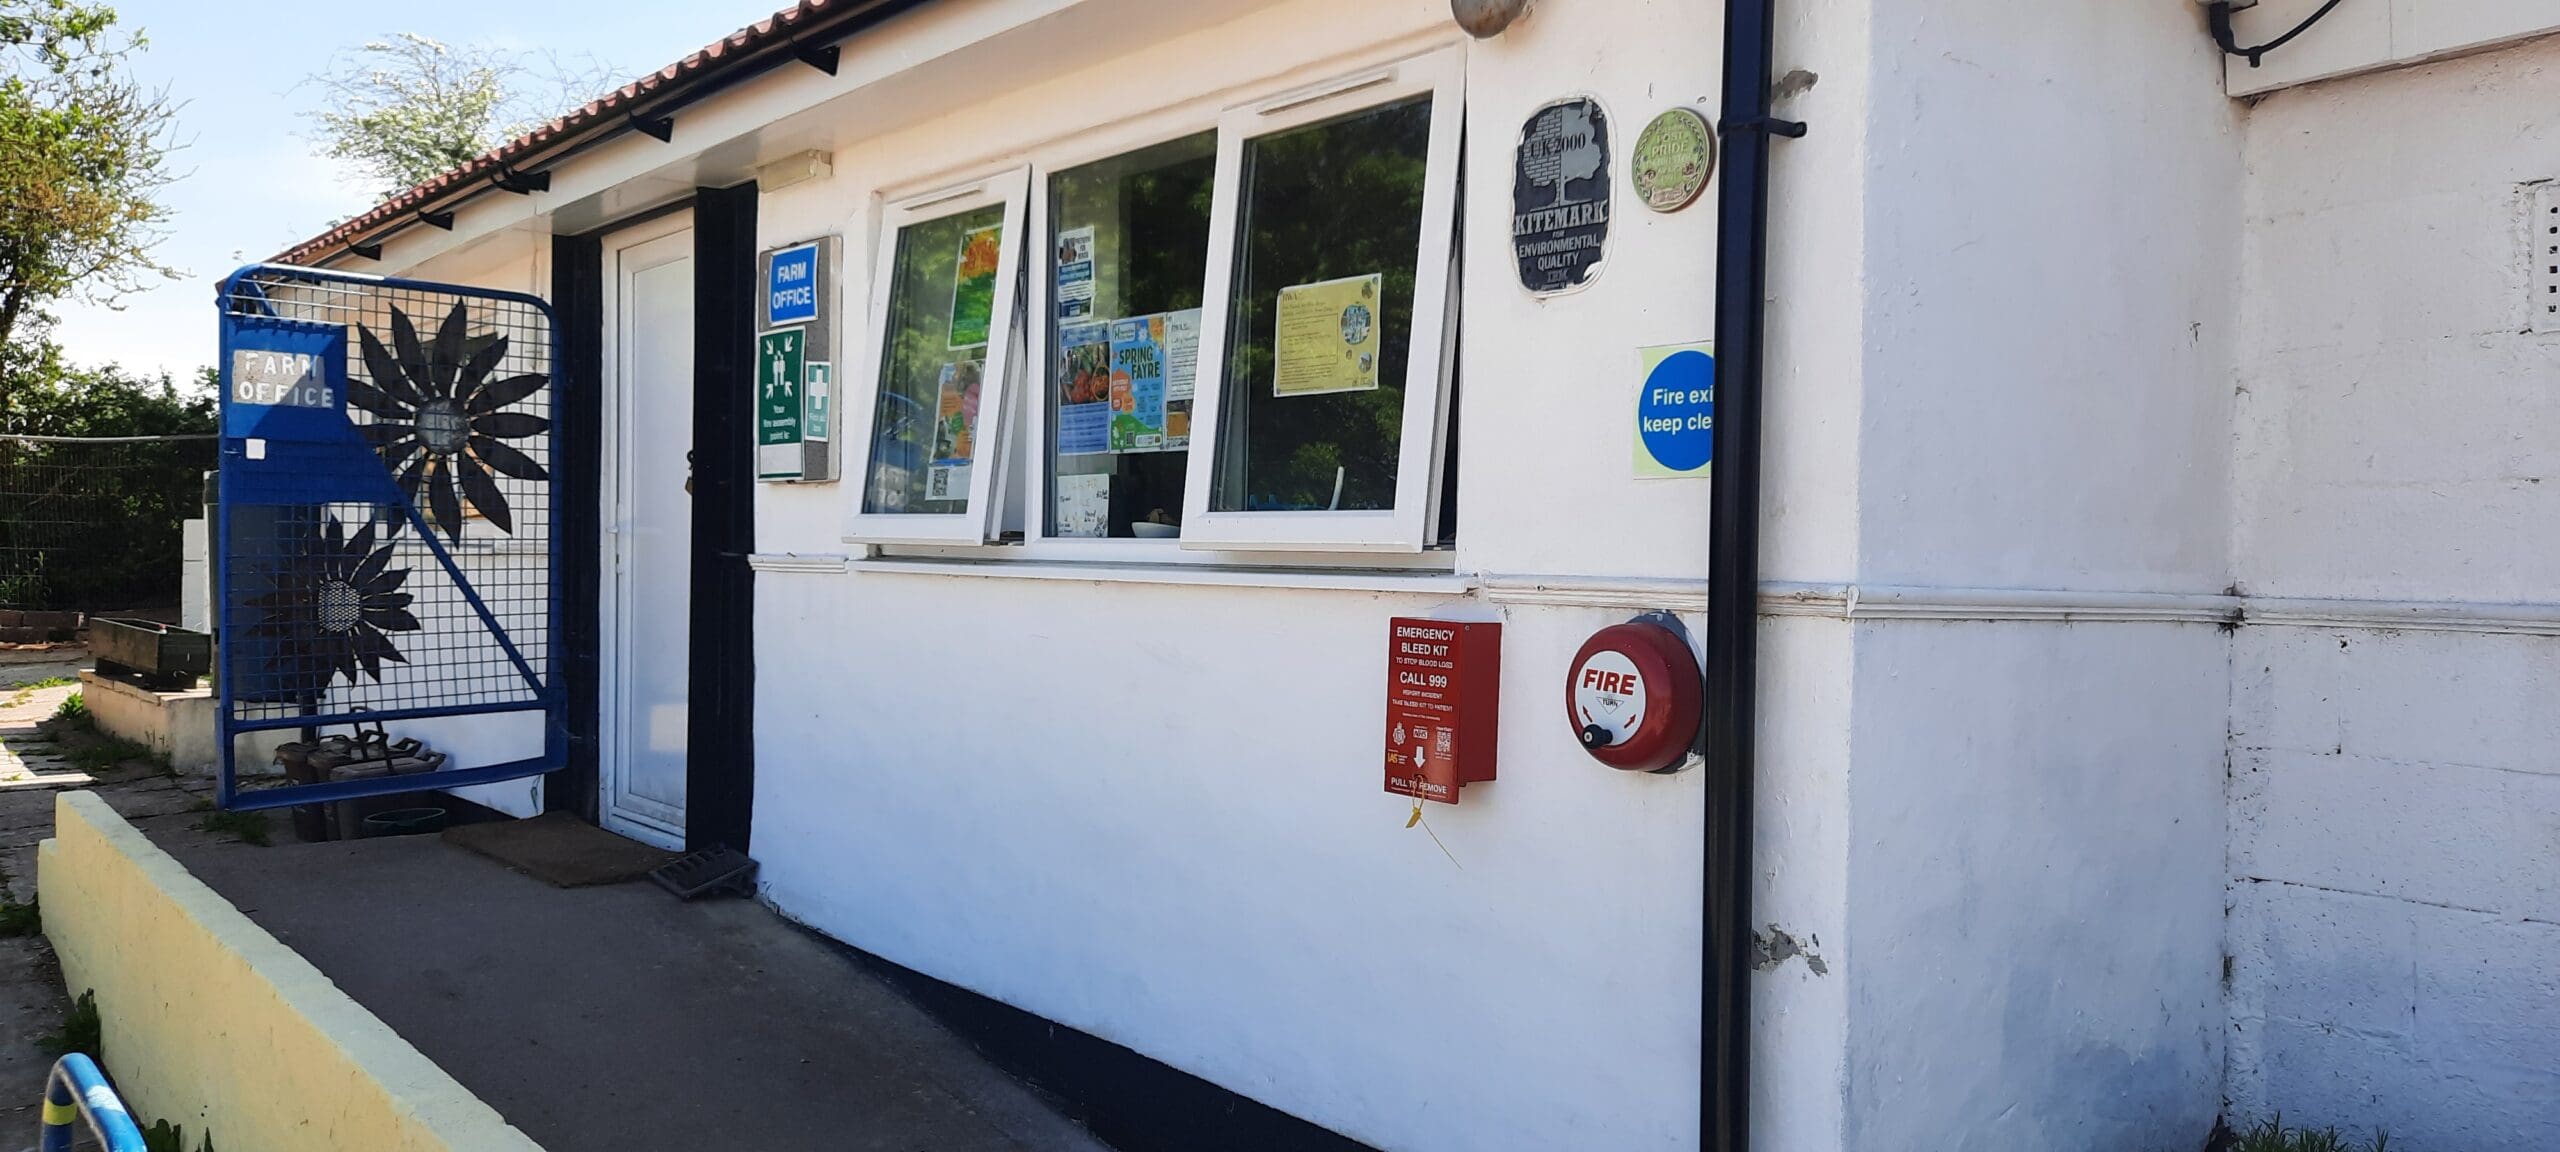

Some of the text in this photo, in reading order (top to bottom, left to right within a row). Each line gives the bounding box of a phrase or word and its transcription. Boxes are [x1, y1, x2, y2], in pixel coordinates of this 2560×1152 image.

[1651, 143, 1690, 158] PRIDE
[1515, 199, 1608, 236] KITEMARK
[1519, 233, 1601, 258] ENVIRONMENTAL
[1537, 252, 1580, 271] QUALITY
[777, 261, 807, 284] FARM
[772, 286, 812, 310] OFFICE
[244, 352, 318, 377] FARM
[1119, 346, 1153, 365] SPRING
[1132, 361, 1161, 380] FAYRE
[239, 381, 334, 409] OFFICE
[1653, 385, 1714, 406] Fire exi
[1643, 412, 1713, 436] keep cle
[770, 432, 784, 442] point
[1396, 626, 1455, 641] EMERGENCY
[1401, 642, 1448, 656] BLEED KIT
[1396, 656, 1453, 669] TO STOP BLOOD LOSS
[1400, 671, 1448, 688] CALL 999
[1583, 668, 1637, 696] FIRE
[1391, 777, 1409, 788] PULL
[1408, 780, 1418, 788] TO
[1418, 782, 1448, 794] REMOVE
